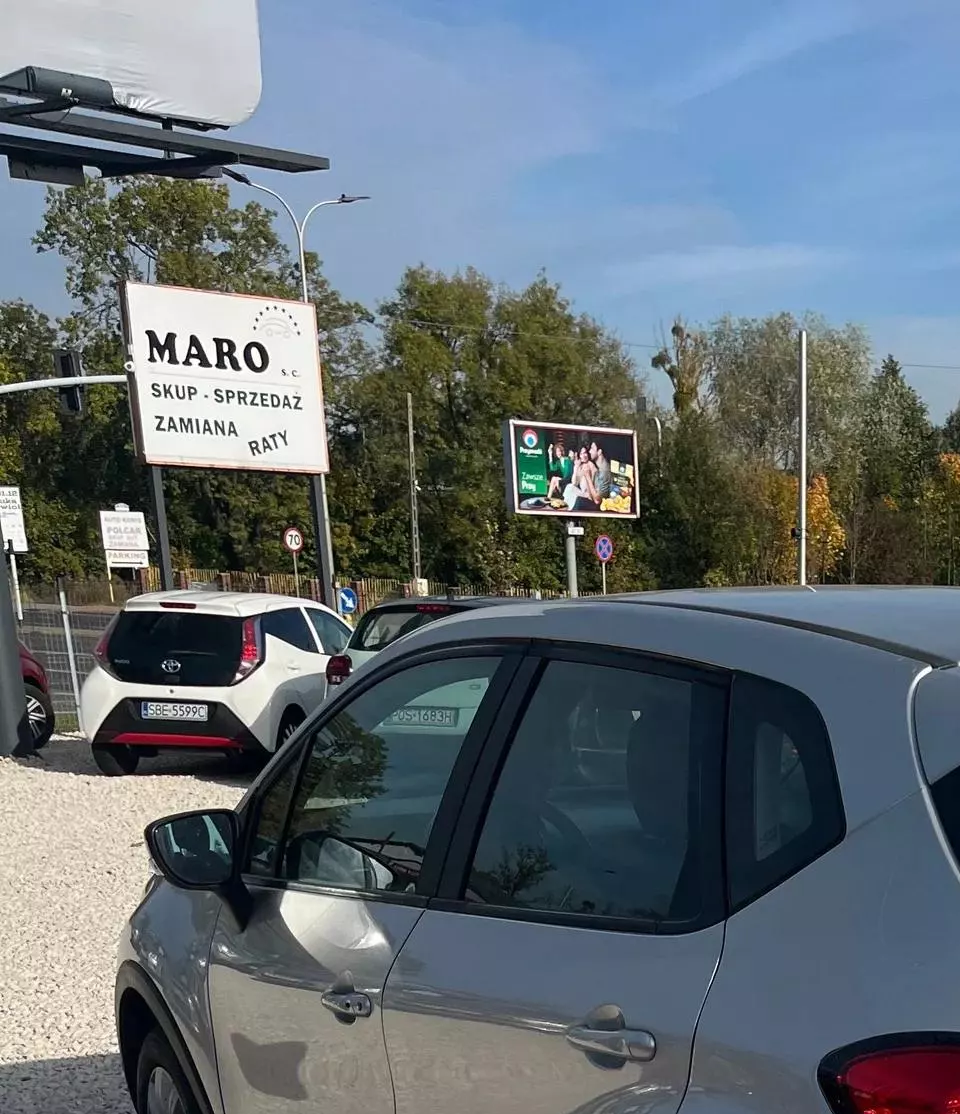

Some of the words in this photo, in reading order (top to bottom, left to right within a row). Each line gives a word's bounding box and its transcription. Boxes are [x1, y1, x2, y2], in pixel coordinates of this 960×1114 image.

[145, 329, 270, 374] MARO
[151, 382, 198, 401] SKUP
[213, 388, 303, 410] SPRZEDAŻ
[155, 415, 239, 437] ZAMIANA
[248, 430, 289, 457] RATY
[288, 534, 301, 546] 70
[107, 552, 146, 560] PARKING
[148, 704, 169, 716] SBE
[172, 705, 205, 718] 5599C
[418, 711, 452, 724] 1683H
